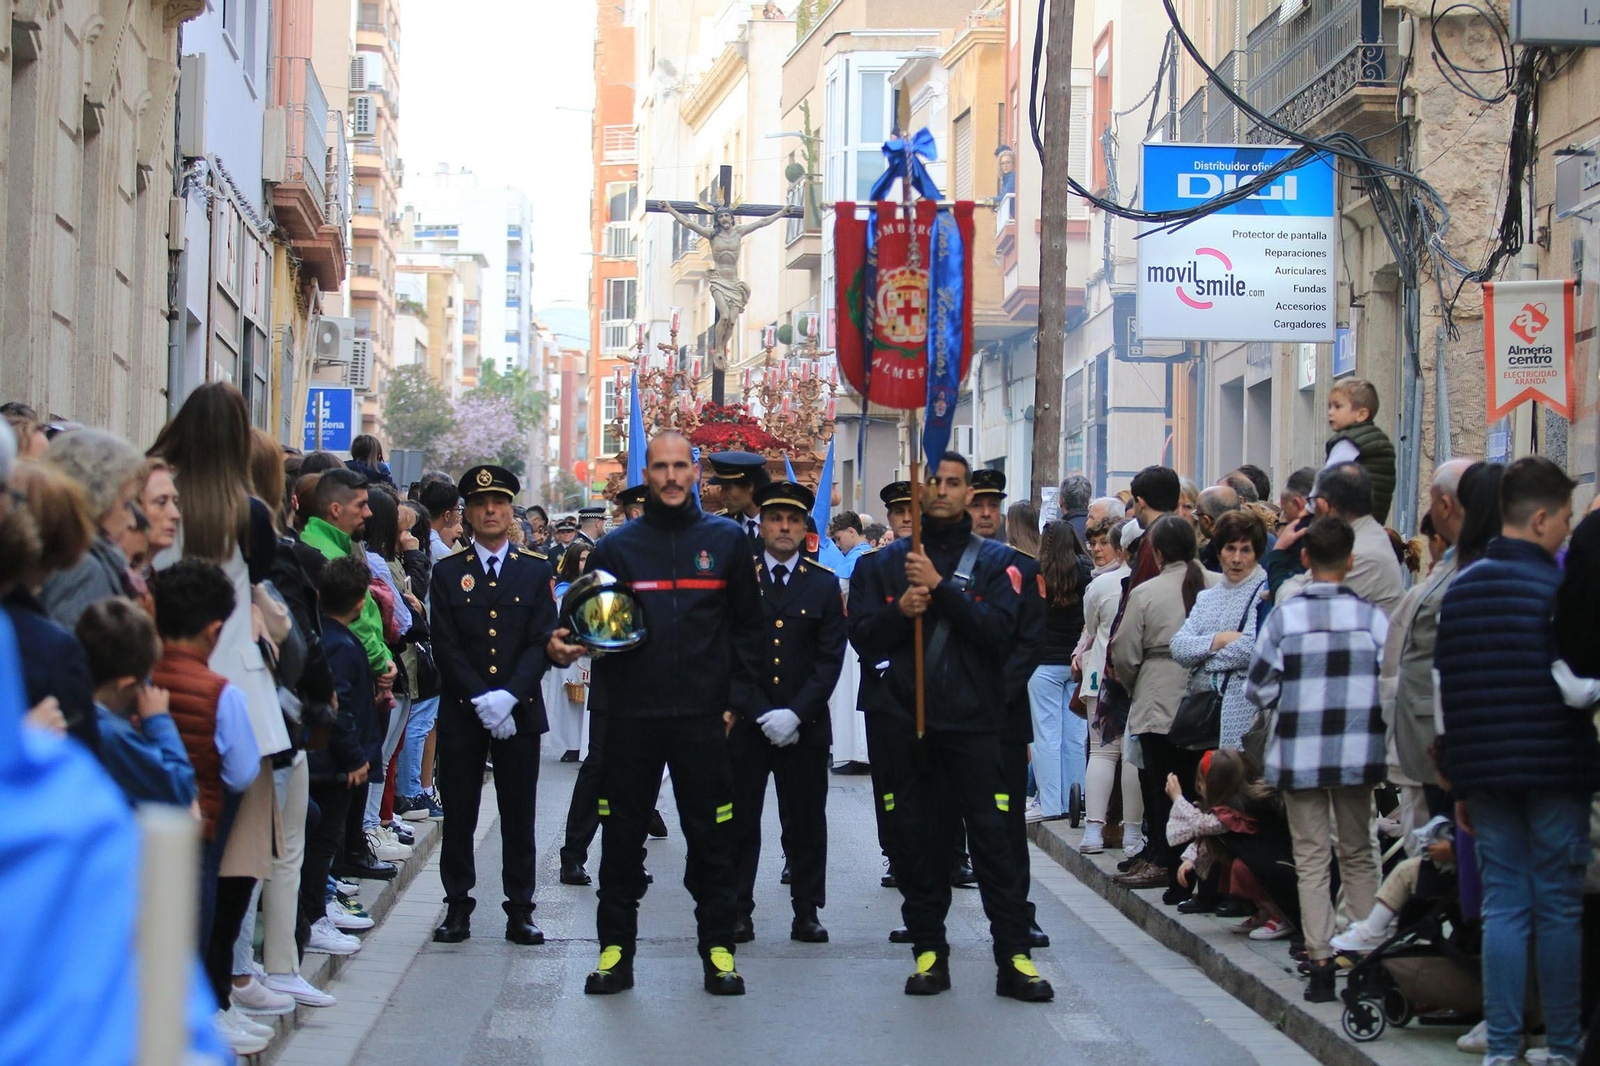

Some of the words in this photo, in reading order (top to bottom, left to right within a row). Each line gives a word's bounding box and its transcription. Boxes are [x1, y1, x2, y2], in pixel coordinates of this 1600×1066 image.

[1194, 161, 1250, 171] Distribuidor
[1252, 161, 1273, 172] ofici
[1232, 230, 1275, 239] Protector
[1277, 230, 1289, 239] de
[1291, 231, 1327, 241] pantalla
[1265, 249, 1327, 259] Reparaciones
[1147, 261, 1198, 284] movil
[1275, 267, 1327, 276] Auriculares
[1293, 284, 1327, 294] Fundas
[1275, 302, 1327, 311] Accesorios
[1274, 320, 1327, 330] Cargadores
[1508, 344, 1553, 355] Almería
[1508, 353, 1552, 365] centro
[1503, 370, 1558, 379] ELECTRICIDAD
